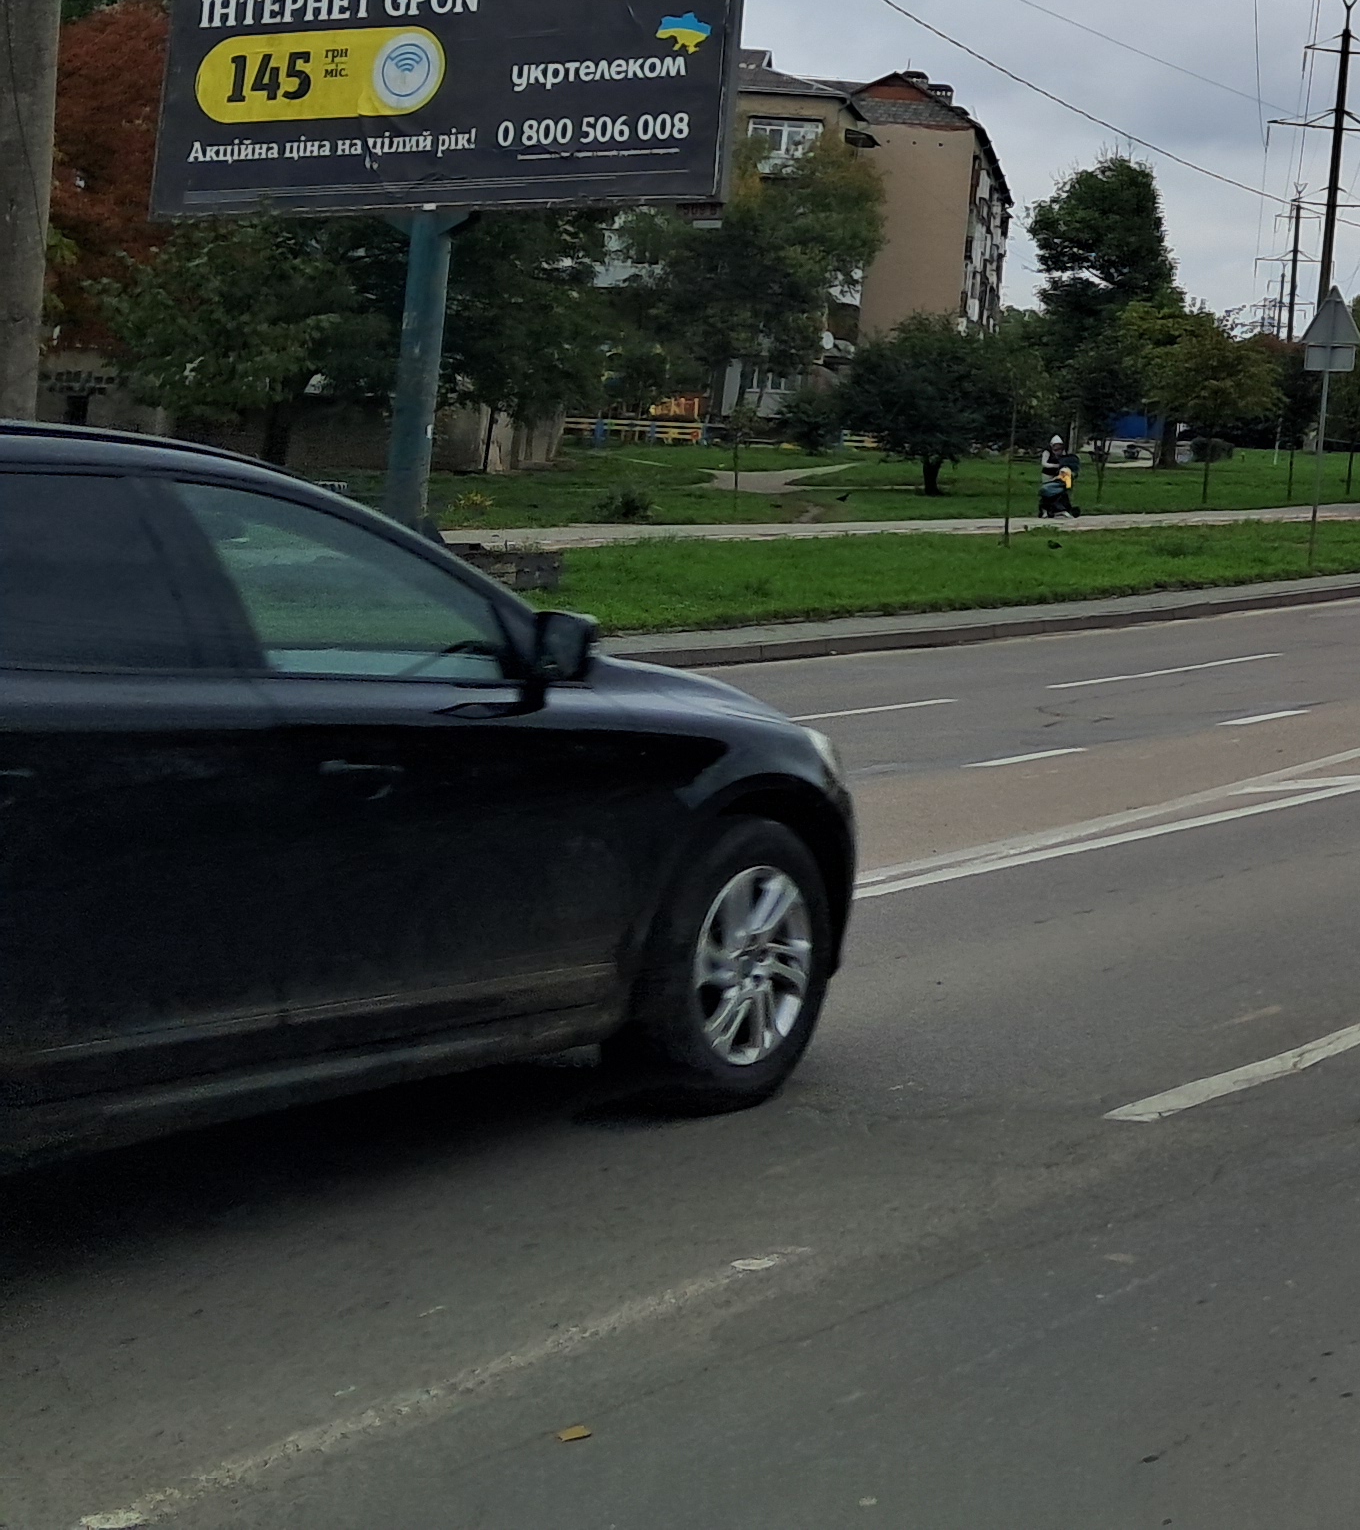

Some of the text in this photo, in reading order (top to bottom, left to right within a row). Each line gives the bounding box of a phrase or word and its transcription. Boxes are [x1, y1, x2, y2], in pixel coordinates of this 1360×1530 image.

[323, 65, 349, 79] міс.
[324, 46, 349, 61] грн
[226, 51, 311, 103] 145
[511, 55, 687, 92] укртелеком
[186, 126, 477, 164] Акційна ціна на цілий рік!
[498, 111, 690, 148] 0 800 506 008
